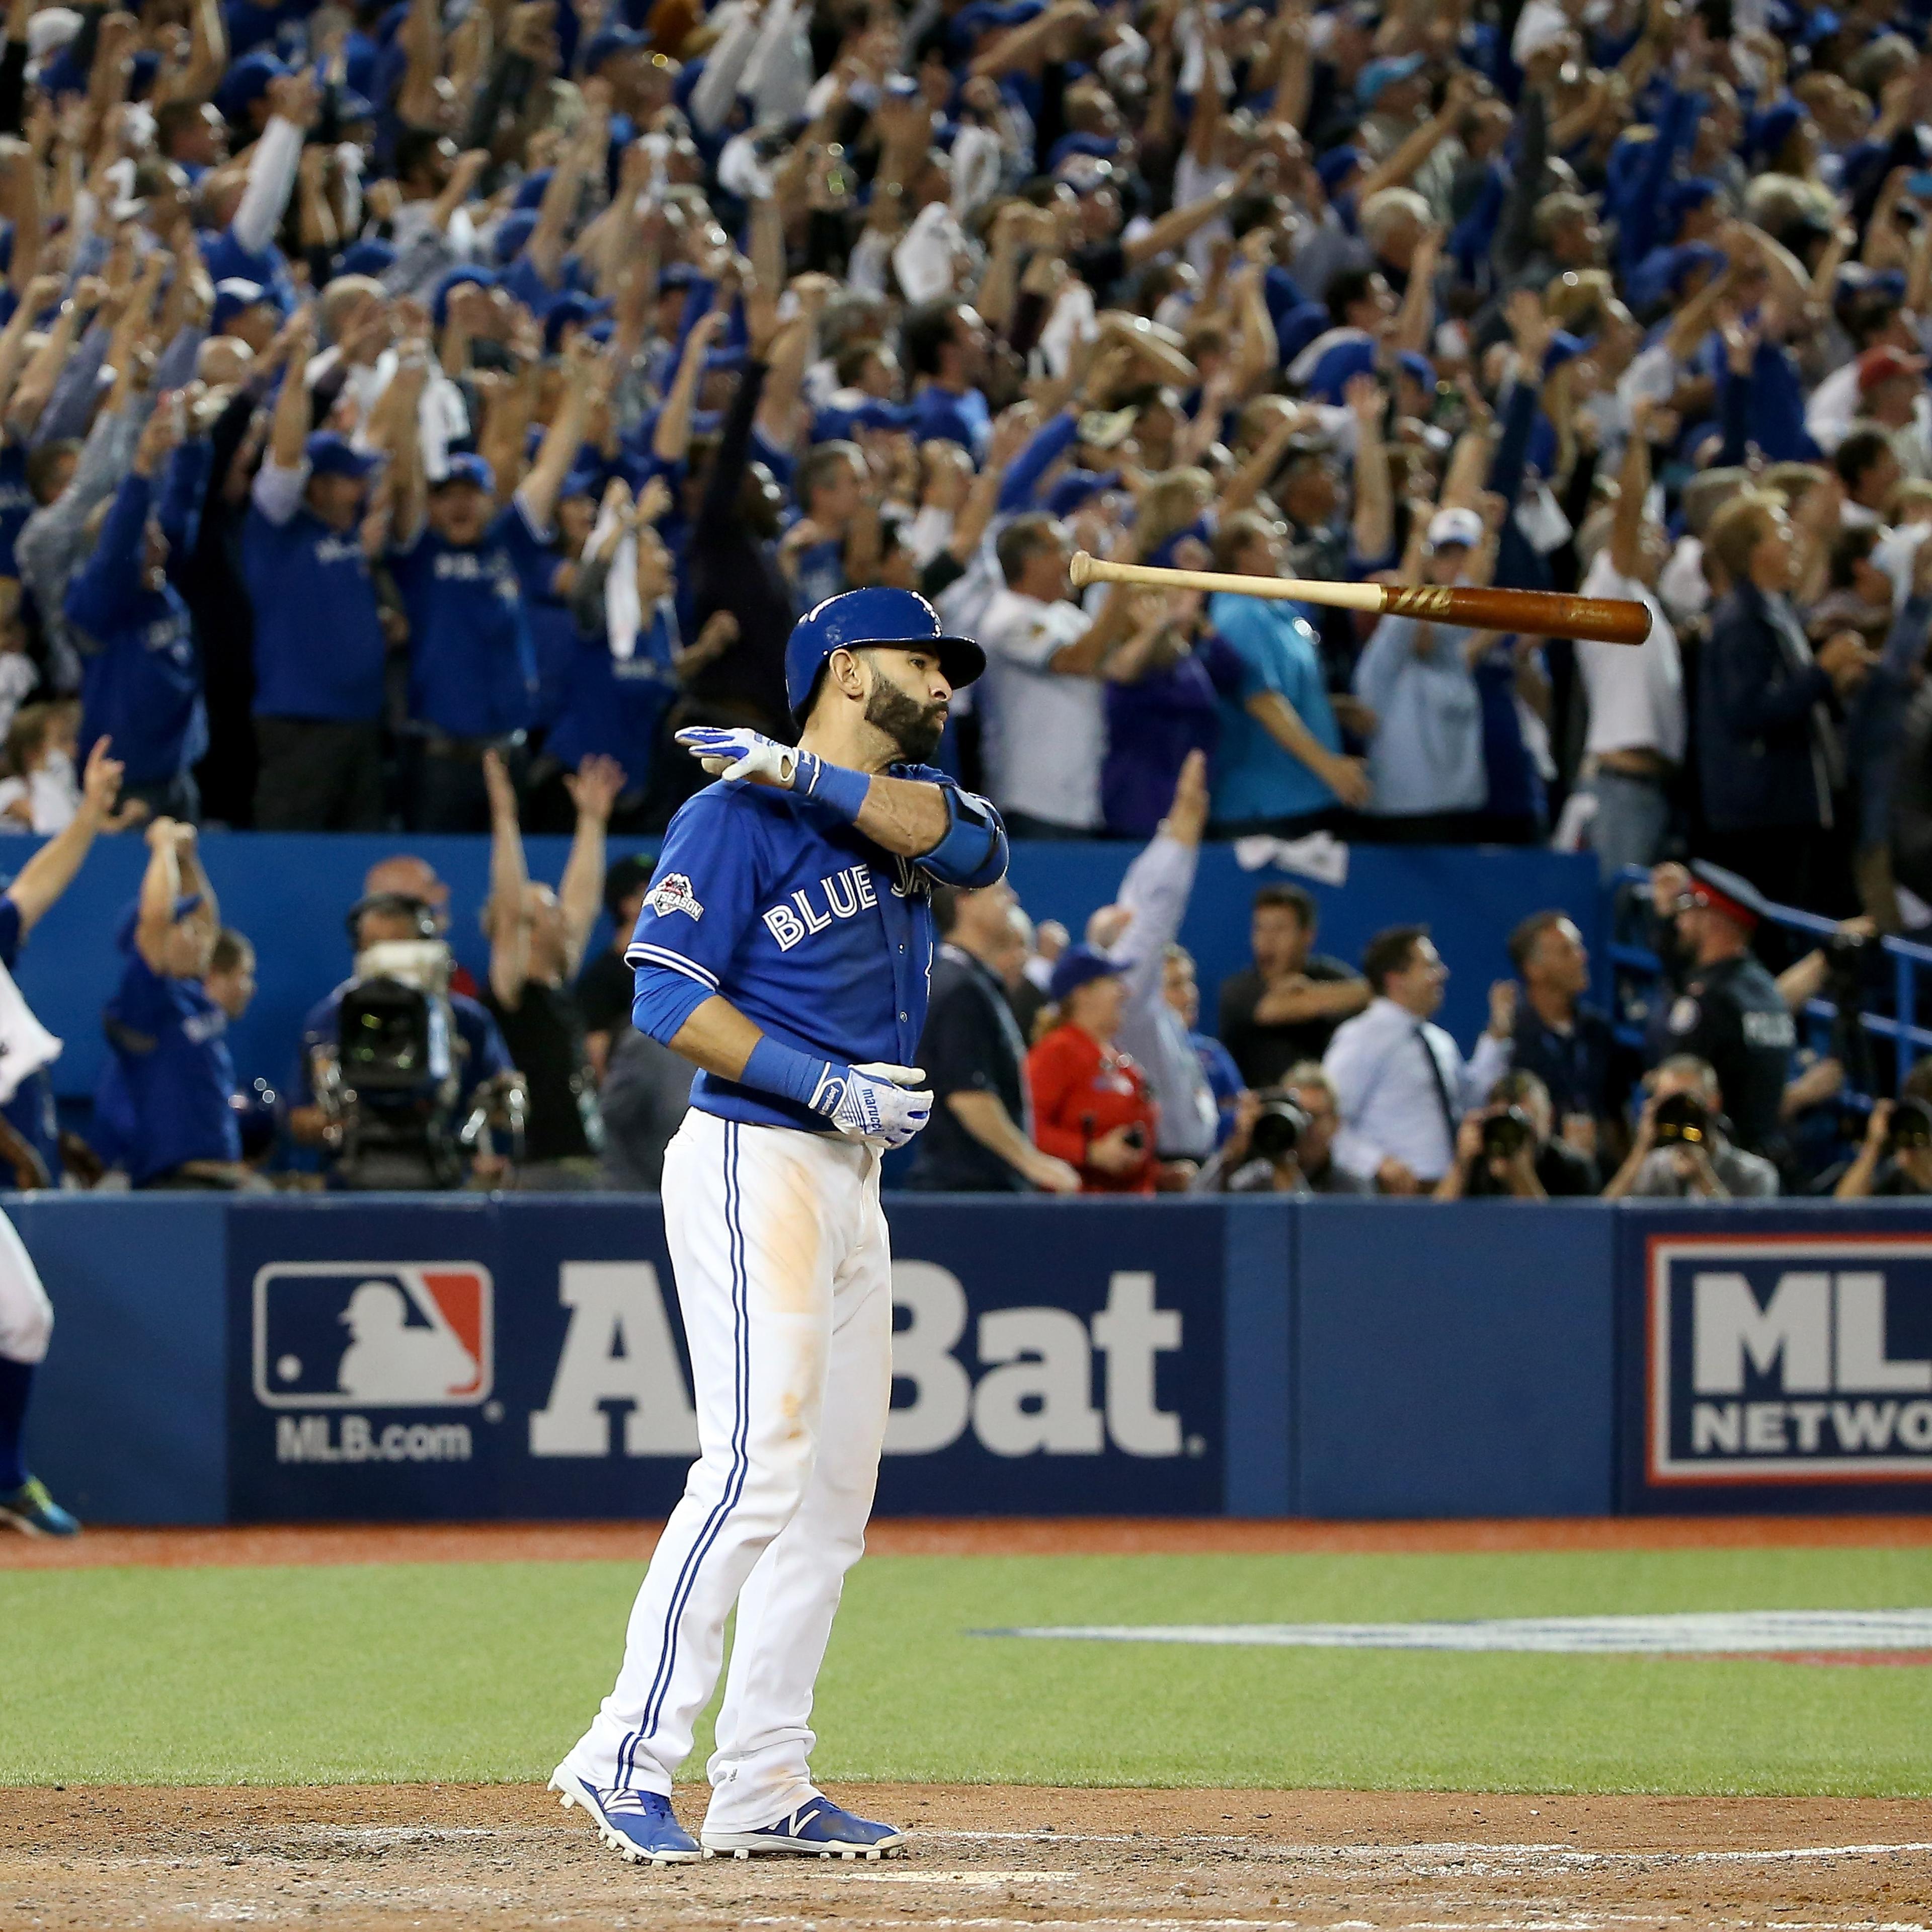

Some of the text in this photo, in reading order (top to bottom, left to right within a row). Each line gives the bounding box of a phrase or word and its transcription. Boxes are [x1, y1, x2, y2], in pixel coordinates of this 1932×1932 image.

[762, 863, 878, 952] BLUE
[861, 1088, 884, 1132] marucci
[881, 1257, 1183, 1457] Bat
[1693, 1271, 1932, 1394] ML
[276, 1414, 473, 1463] MLB.com
[1692, 1400, 1932, 1453] NETWO
